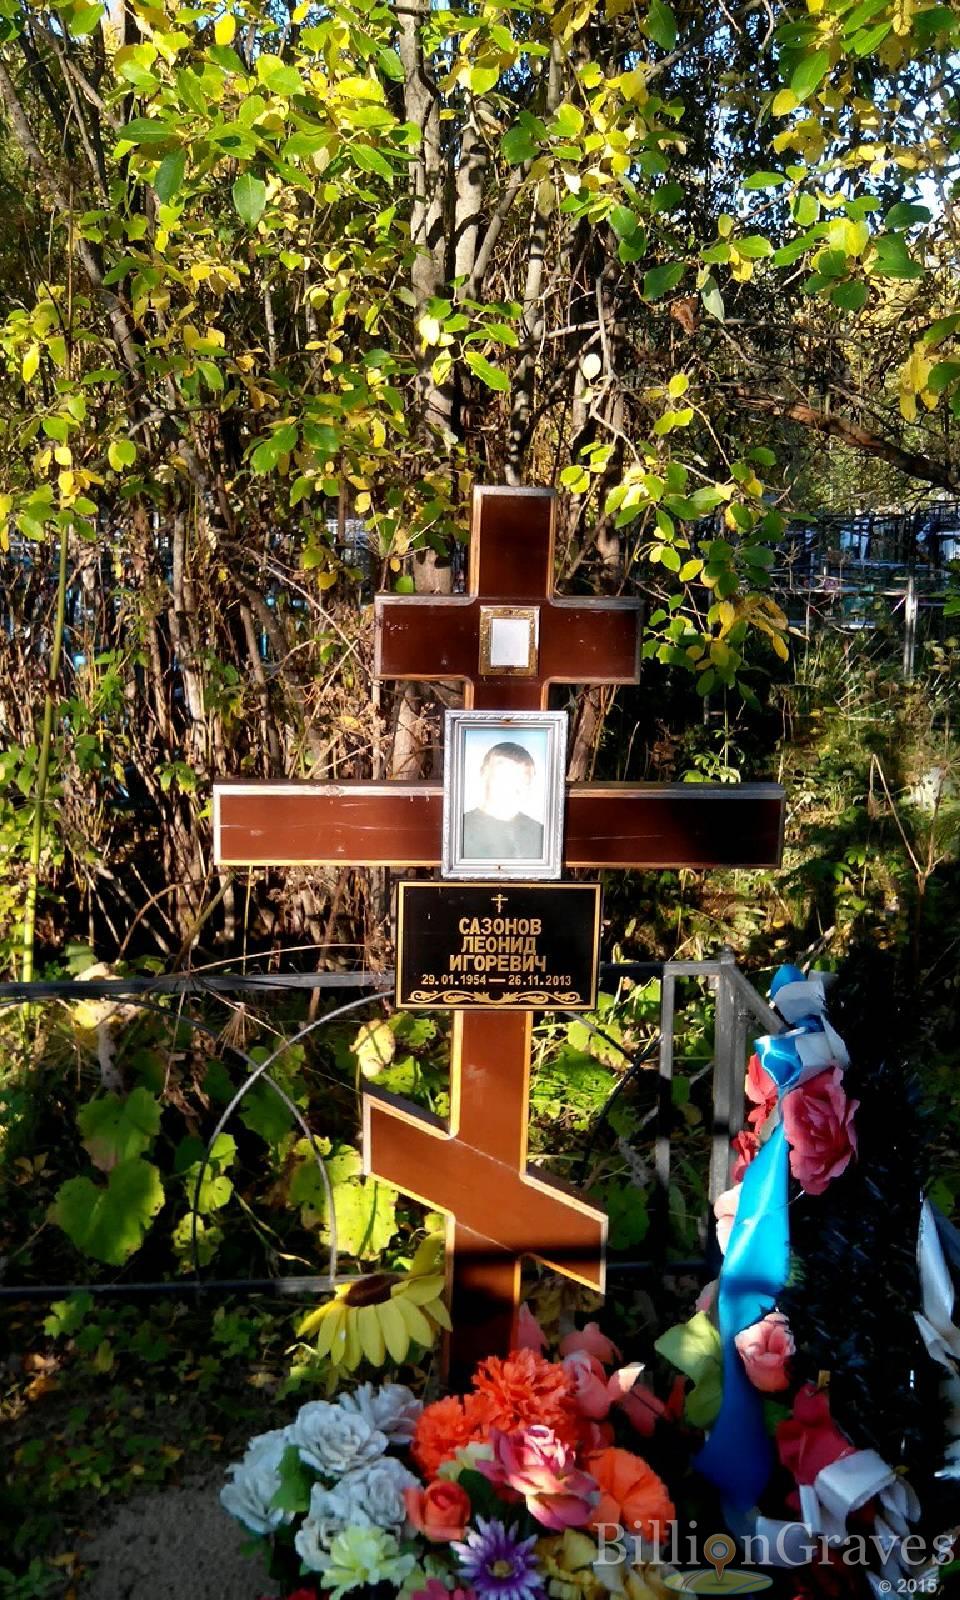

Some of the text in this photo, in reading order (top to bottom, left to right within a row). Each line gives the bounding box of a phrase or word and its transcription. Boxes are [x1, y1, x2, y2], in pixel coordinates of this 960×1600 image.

[459, 918, 542, 935] САЗОНОВ
[461, 936, 537, 955] ЛЕОНИД
[449, 954, 547, 972] ИГОРЕВИЧ
